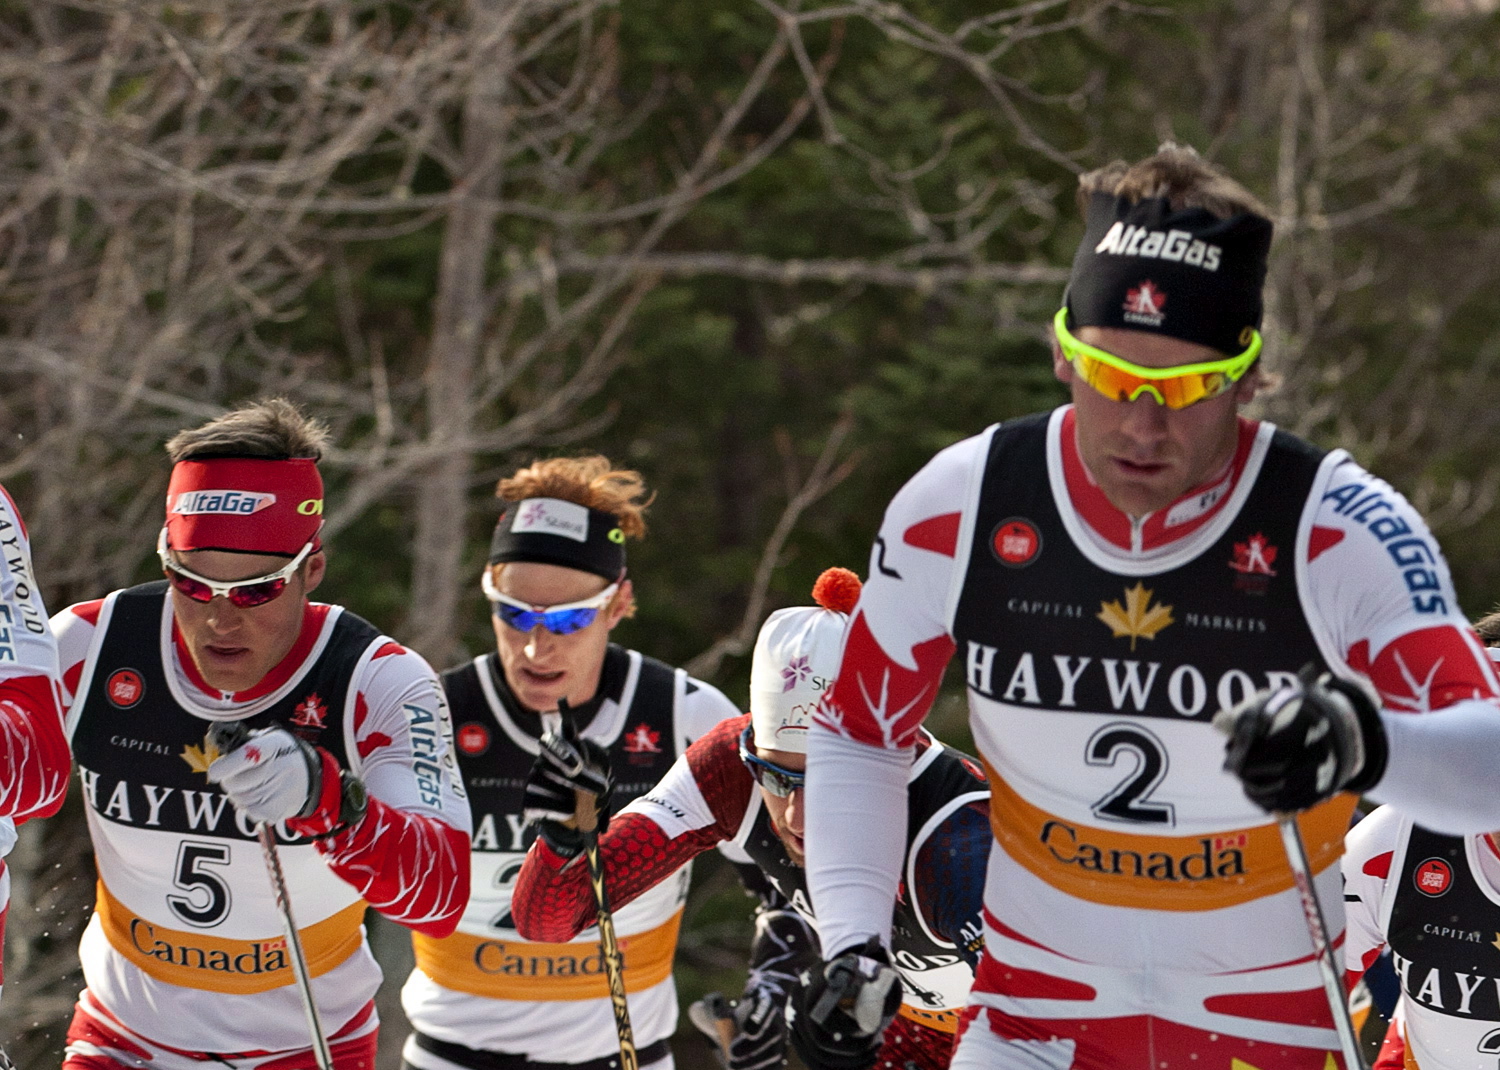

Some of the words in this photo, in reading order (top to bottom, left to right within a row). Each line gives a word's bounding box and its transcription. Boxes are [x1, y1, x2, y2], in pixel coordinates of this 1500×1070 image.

[1095, 221, 1223, 272] AltaGas
[176, 492, 264, 513] AltaGa
[1186, 613, 1266, 633] MARKETS
[110, 735, 170, 755] CAPITAL
[1085, 721, 1176, 827] 2
[1041, 821, 1248, 881] Canada
[167, 839, 232, 929] 5
[131, 919, 289, 975] Canada
[1423, 923, 1482, 943] CAPITAL
